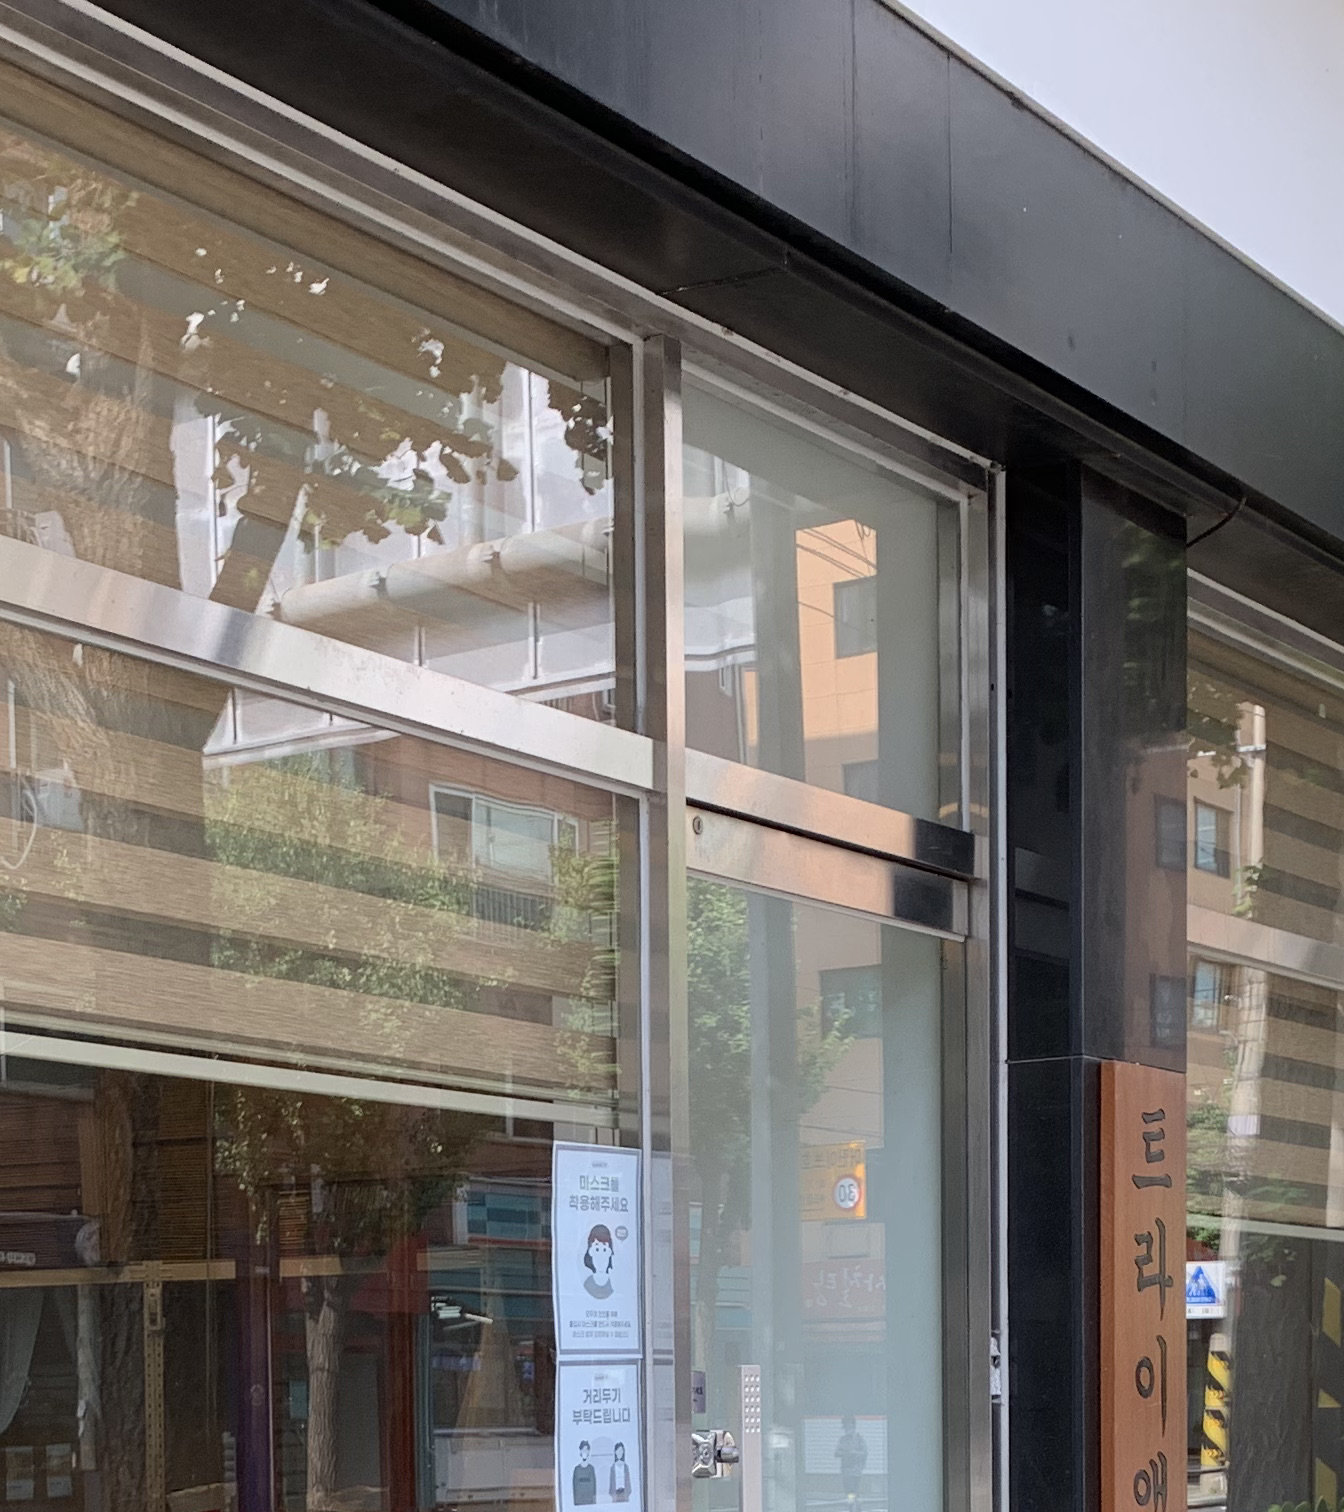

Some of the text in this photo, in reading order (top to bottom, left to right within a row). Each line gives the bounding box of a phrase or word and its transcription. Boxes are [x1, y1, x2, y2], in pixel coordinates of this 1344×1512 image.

[579, 1174, 620, 1193] 마스크를
[568, 1194, 629, 1213] 착용해주세요
[582, 1387, 621, 1404] 거리두기
[572, 1407, 631, 1426] 부탁드립니다
